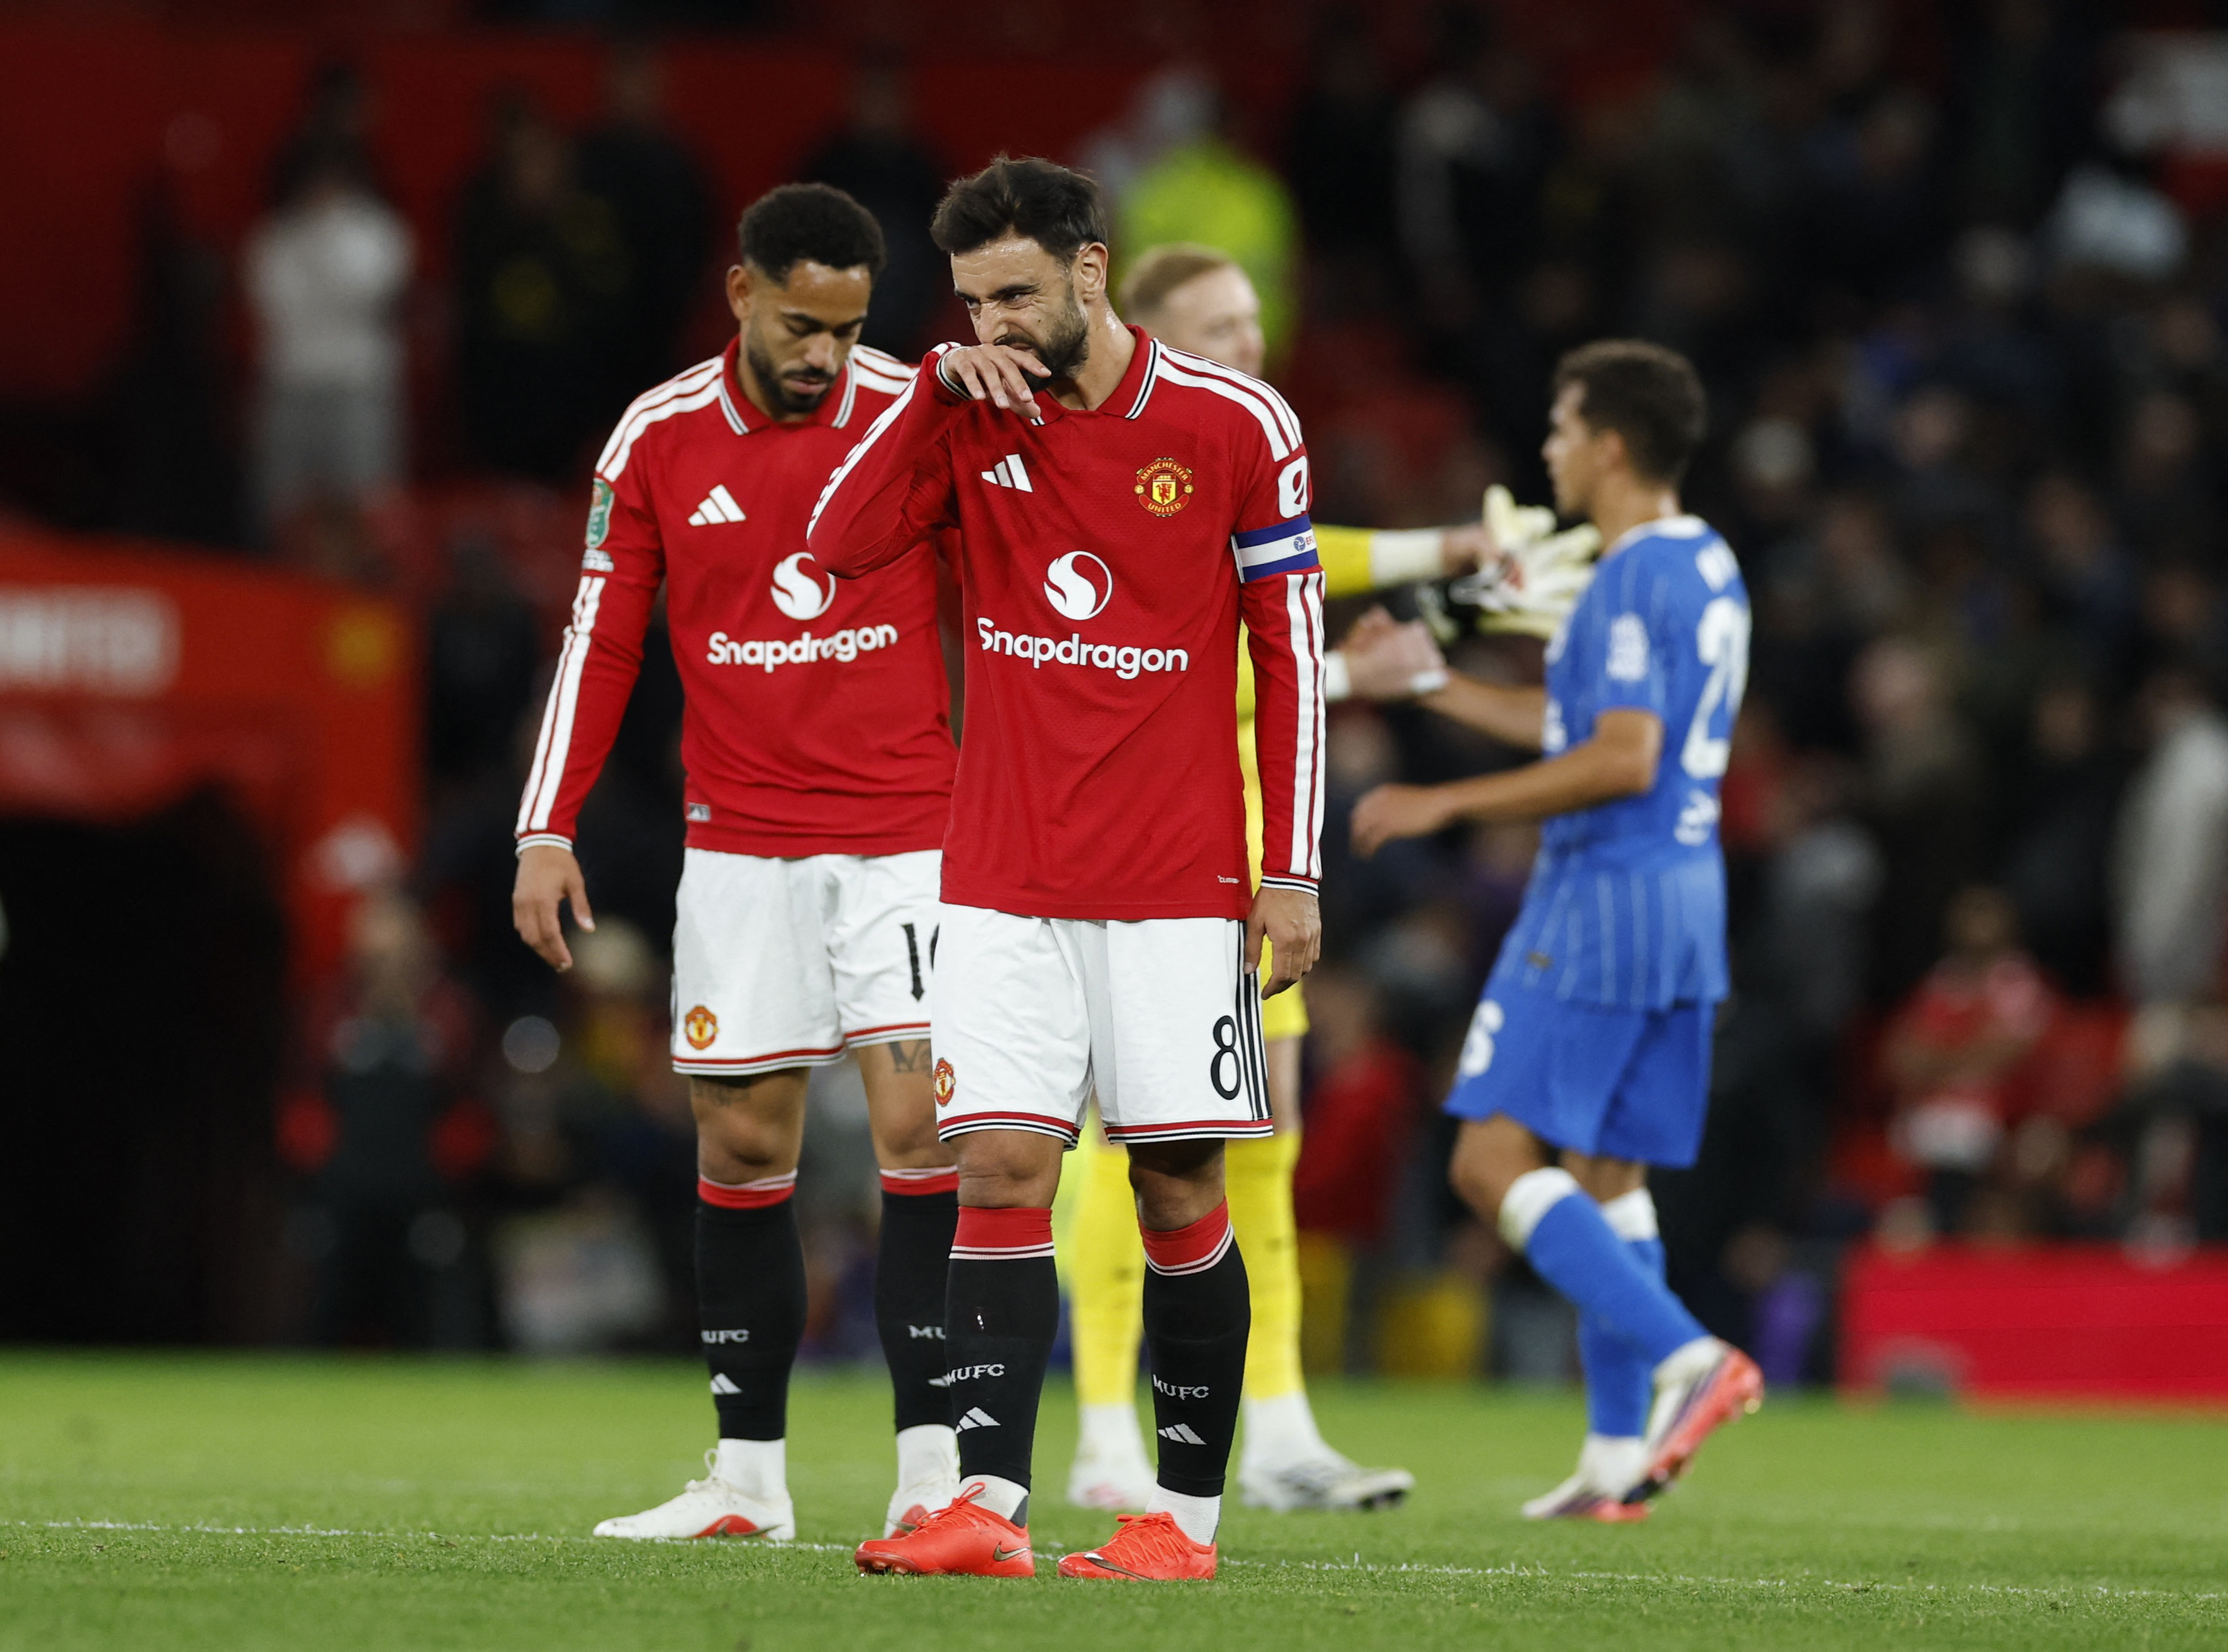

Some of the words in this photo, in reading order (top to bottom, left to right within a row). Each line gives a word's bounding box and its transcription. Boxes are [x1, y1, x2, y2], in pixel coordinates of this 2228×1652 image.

[1141, 462, 1188, 481] MANCHESTER
[1148, 502, 1182, 513] UNITED
[707, 624, 898, 673] Snapdragon
[977, 617, 1189, 680] Snapdragon
[900, 922, 940, 1002] 1
[1211, 1015, 1241, 1100] 8
[700, 1328, 750, 1345] UFC
[947, 1363, 1006, 1387] MUFC
[1153, 1374, 1209, 1401] MUFC
